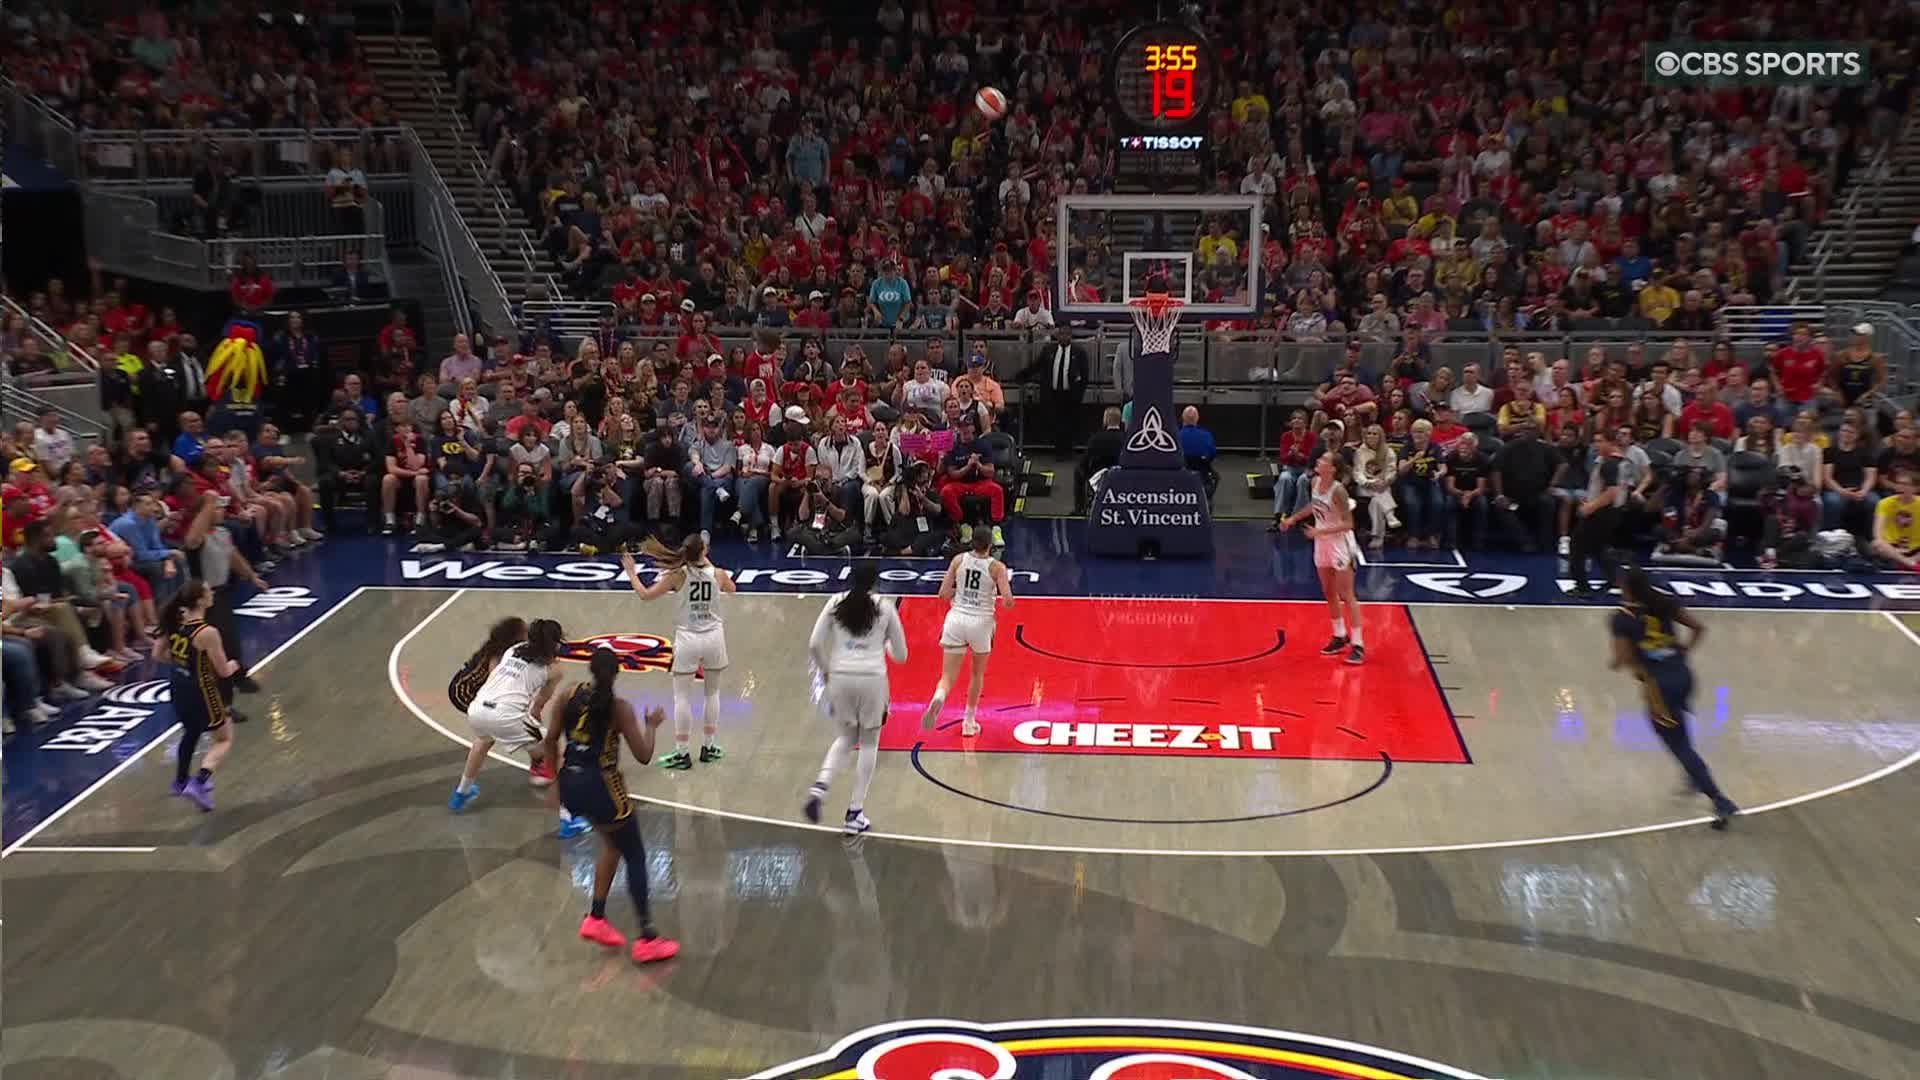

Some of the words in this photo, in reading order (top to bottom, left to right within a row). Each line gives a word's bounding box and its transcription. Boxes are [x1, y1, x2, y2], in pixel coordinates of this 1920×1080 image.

[1145, 45, 1198, 71] 3:55
[1152, 70, 1193, 118] 19
[1143, 136, 1203, 150] TISSOT
[1102, 488, 1198, 505] Ascension
[1100, 509, 1125, 525] St.
[1127, 509, 1201, 525] Vincent
[965, 568, 982, 590] 18
[689, 581, 712, 601] 20
[40, 704, 155, 754] AT&T
